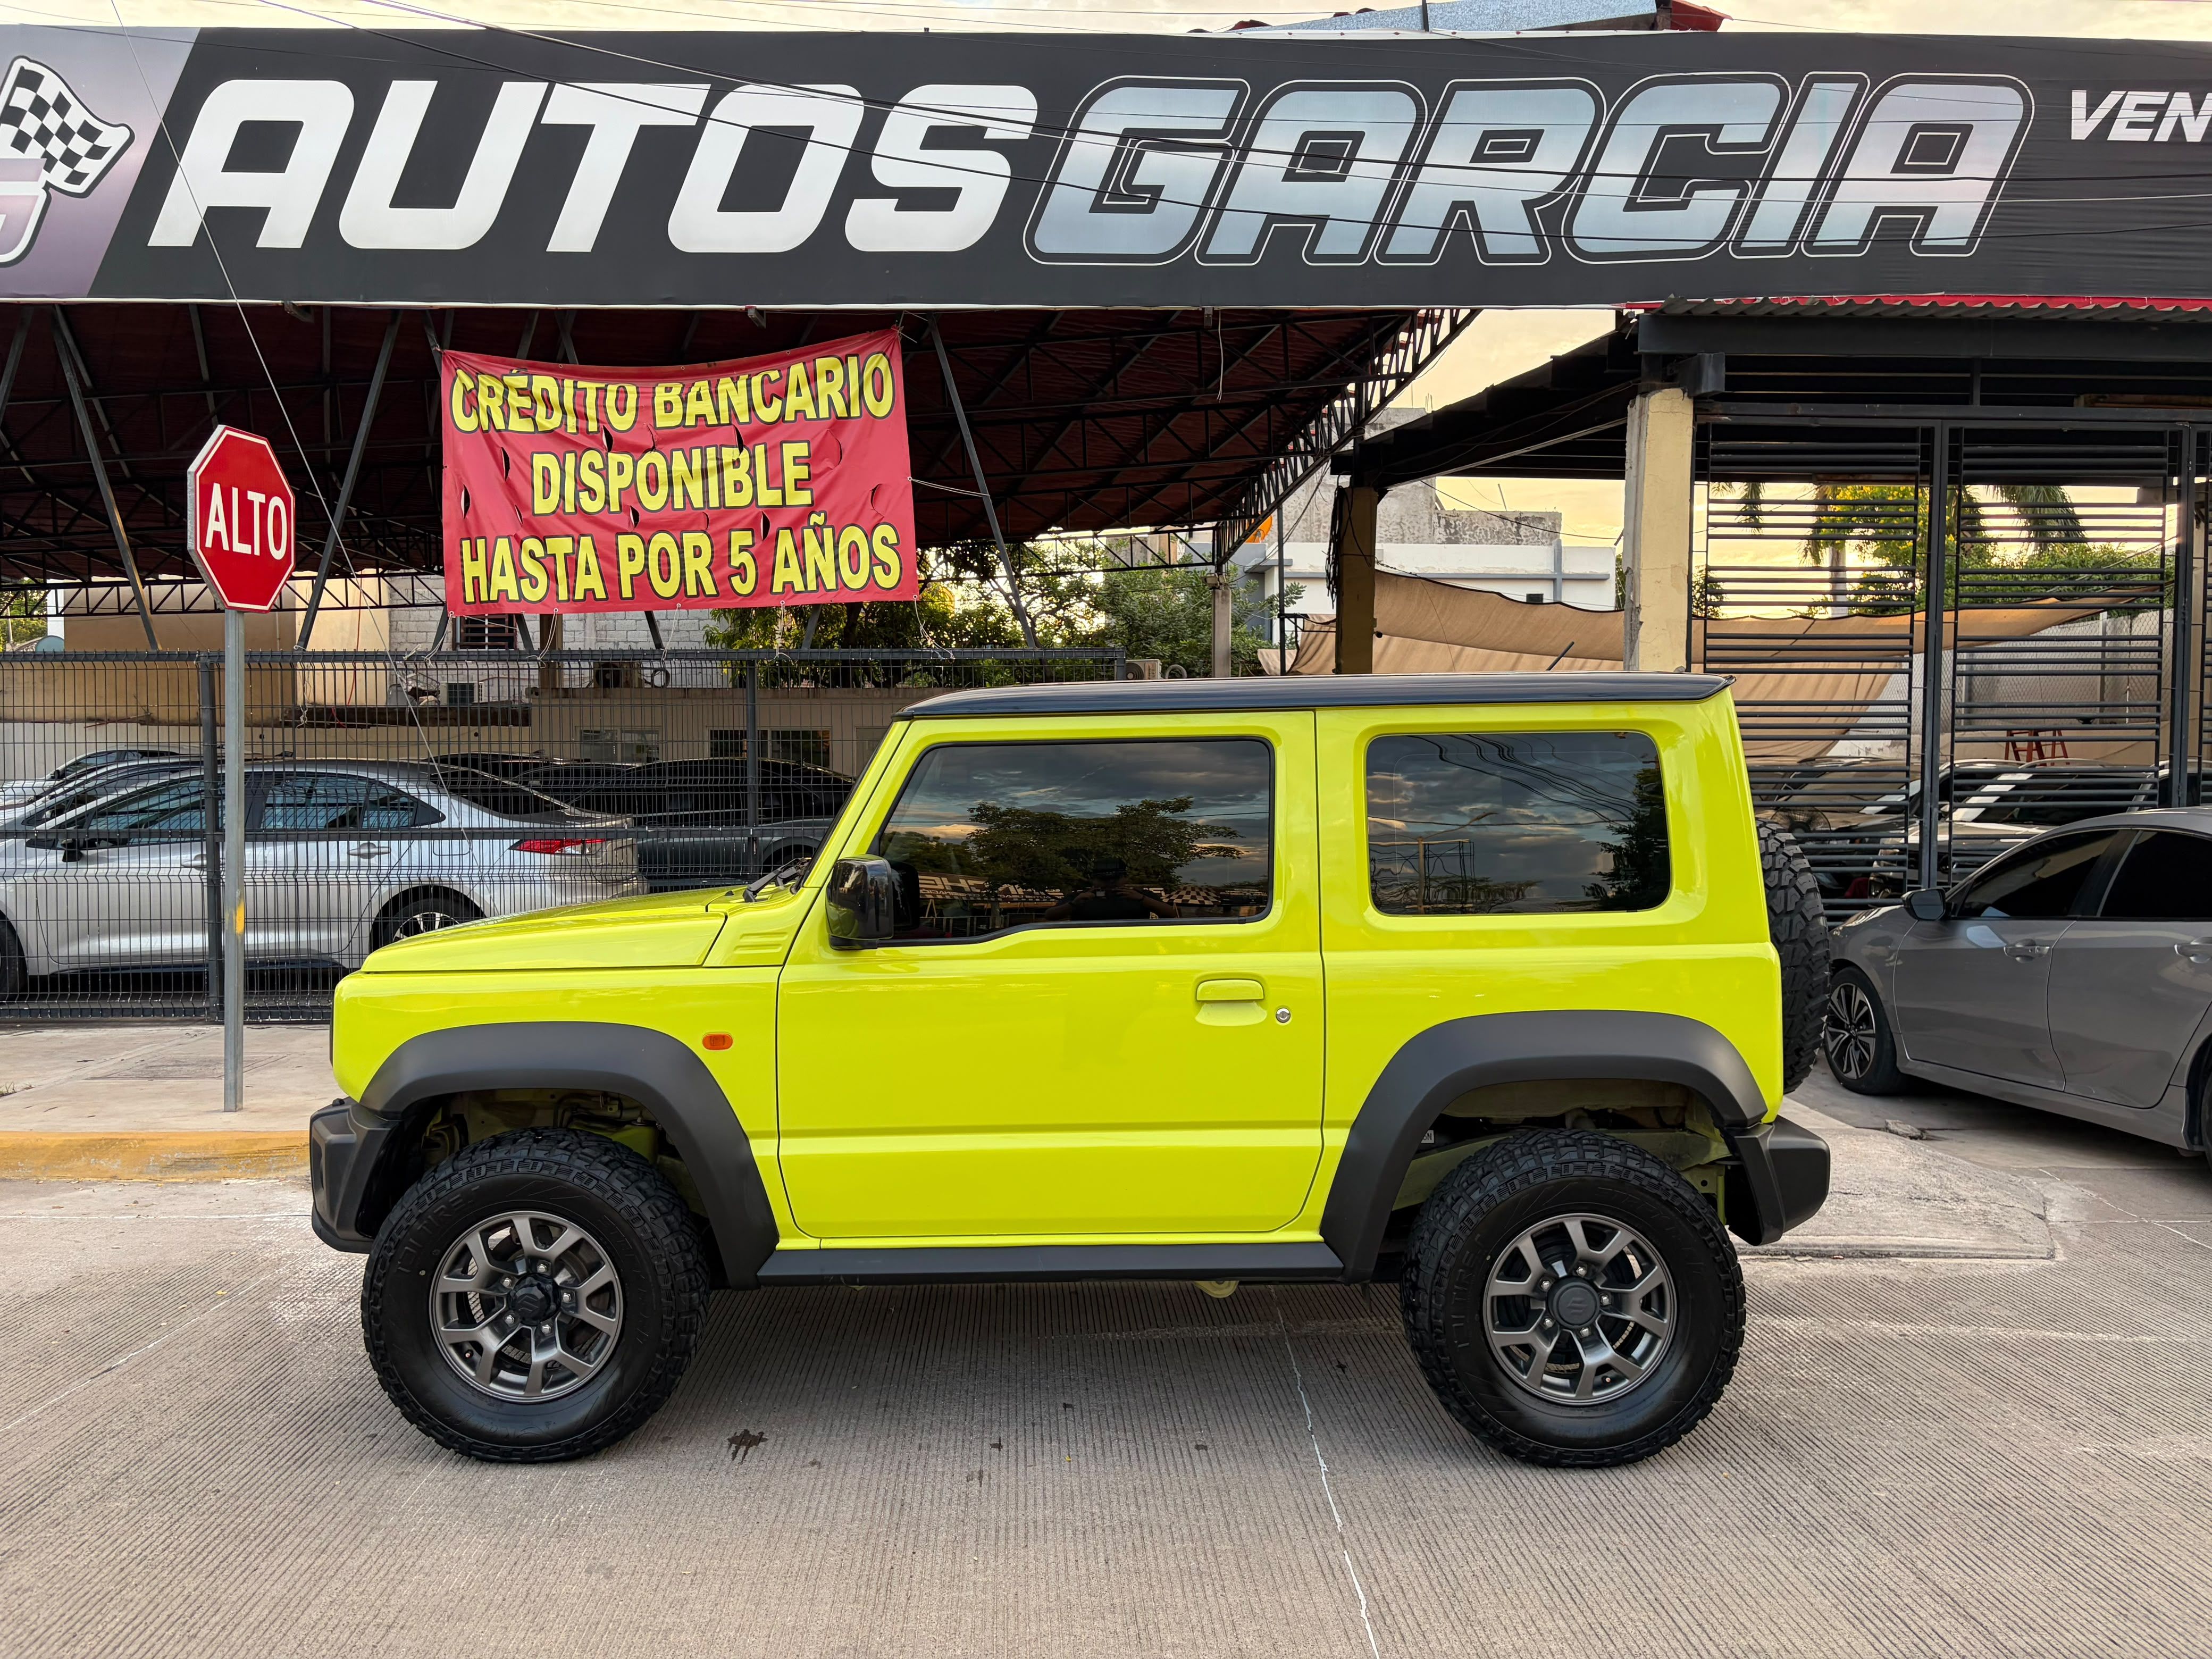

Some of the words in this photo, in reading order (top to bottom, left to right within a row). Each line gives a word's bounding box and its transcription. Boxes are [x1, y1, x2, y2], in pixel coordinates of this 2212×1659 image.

[2071, 89, 2212, 143] VEN
[148, 79, 1038, 253] AUTOS
[1024, 71, 2035, 266] GARCIA
[449, 367, 640, 434] CRÉDITO
[652, 351, 895, 430] BANCARIO
[530, 439, 814, 516] DISPONIBLE
[205, 482, 288, 560] ALTO
[460, 533, 609, 605] HASTA
[617, 530, 720, 601] POR
[727, 527, 758, 598] 5
[770, 510, 902, 595] AÑOS
